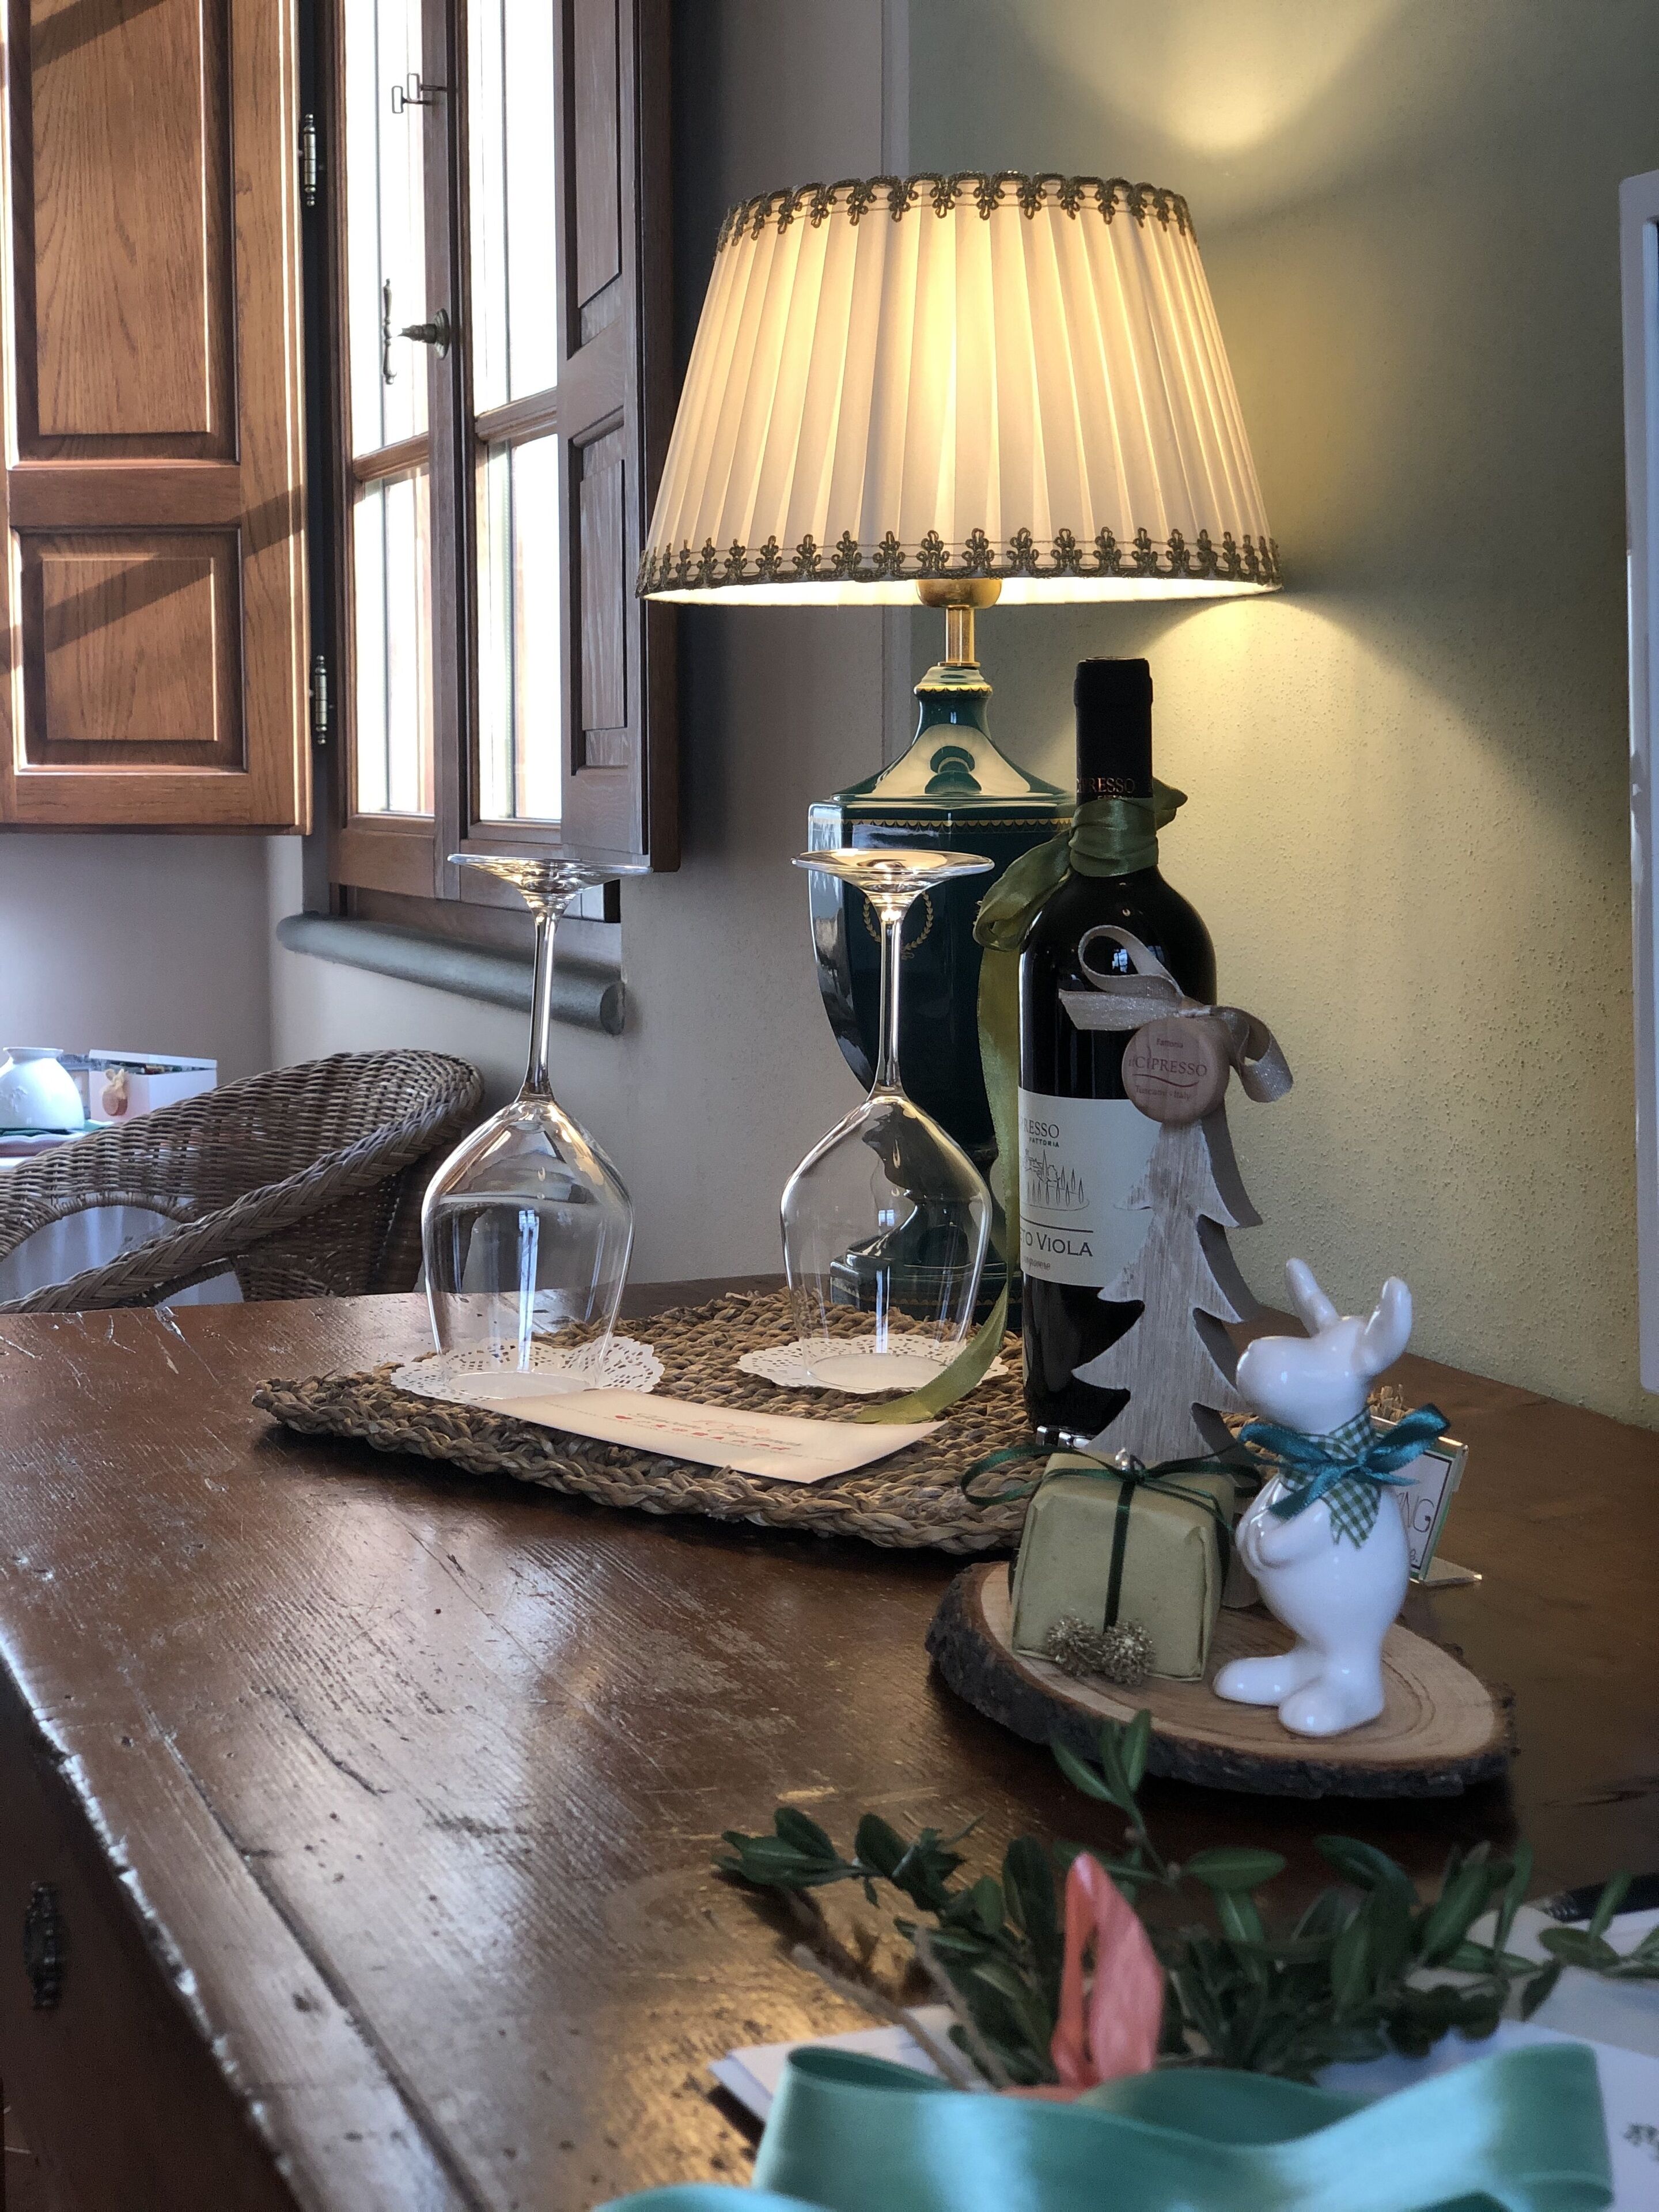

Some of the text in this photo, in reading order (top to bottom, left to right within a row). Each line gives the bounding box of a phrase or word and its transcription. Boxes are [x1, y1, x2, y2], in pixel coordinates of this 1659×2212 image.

[1135, 1055, 1207, 1077] CIPRESSO
[1022, 1118, 1059, 1139] RESSO
[1029, 1137, 1059, 1148] FATTORIA
[1036, 1232, 1093, 1257] VIOLA
